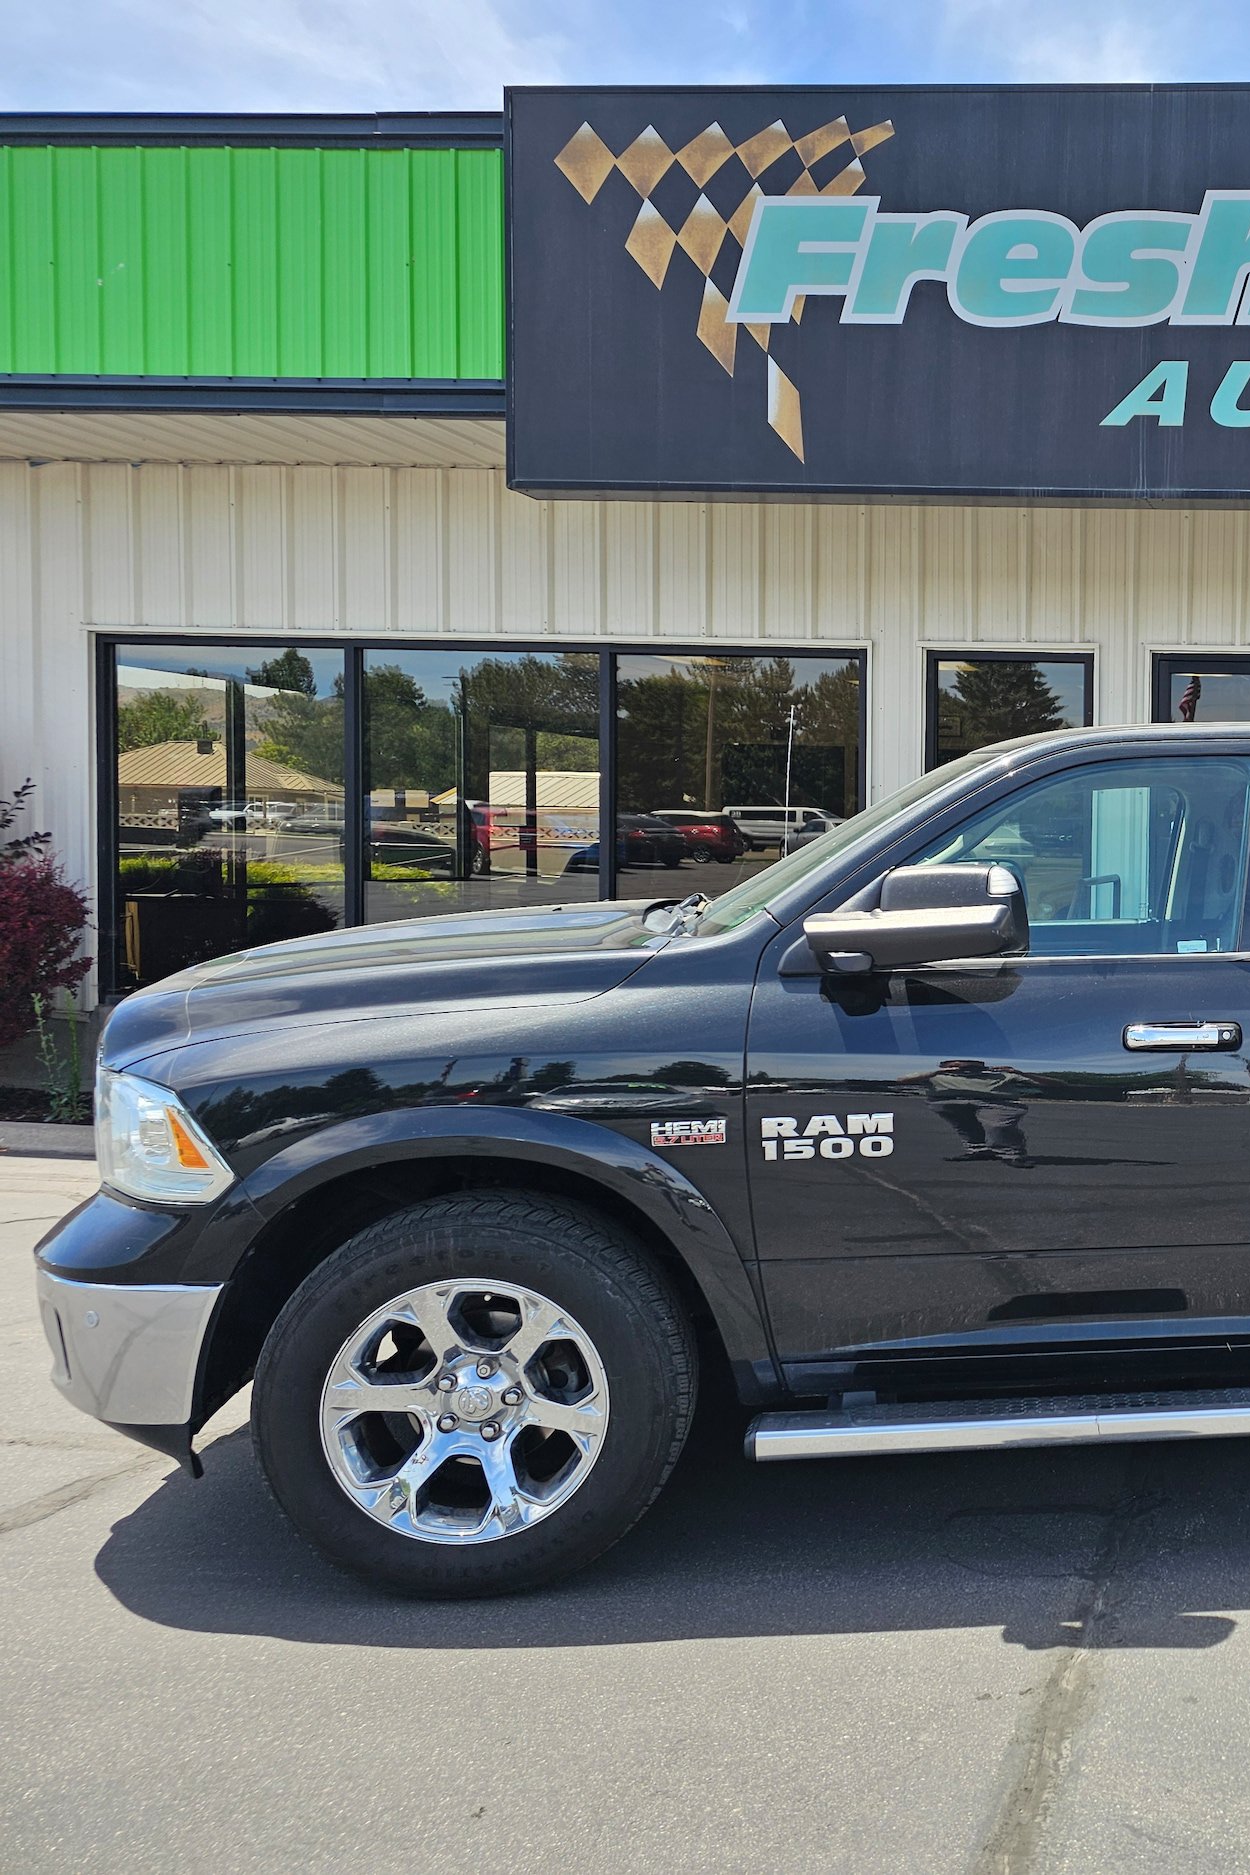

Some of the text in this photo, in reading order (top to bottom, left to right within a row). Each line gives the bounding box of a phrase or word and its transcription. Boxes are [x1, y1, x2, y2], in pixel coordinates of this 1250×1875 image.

[650, 1119, 727, 1135] HEMI
[761, 1112, 894, 1138] RAM
[654, 1133, 724, 1145] 5.7 LITER
[761, 1136, 894, 1161] 1500
